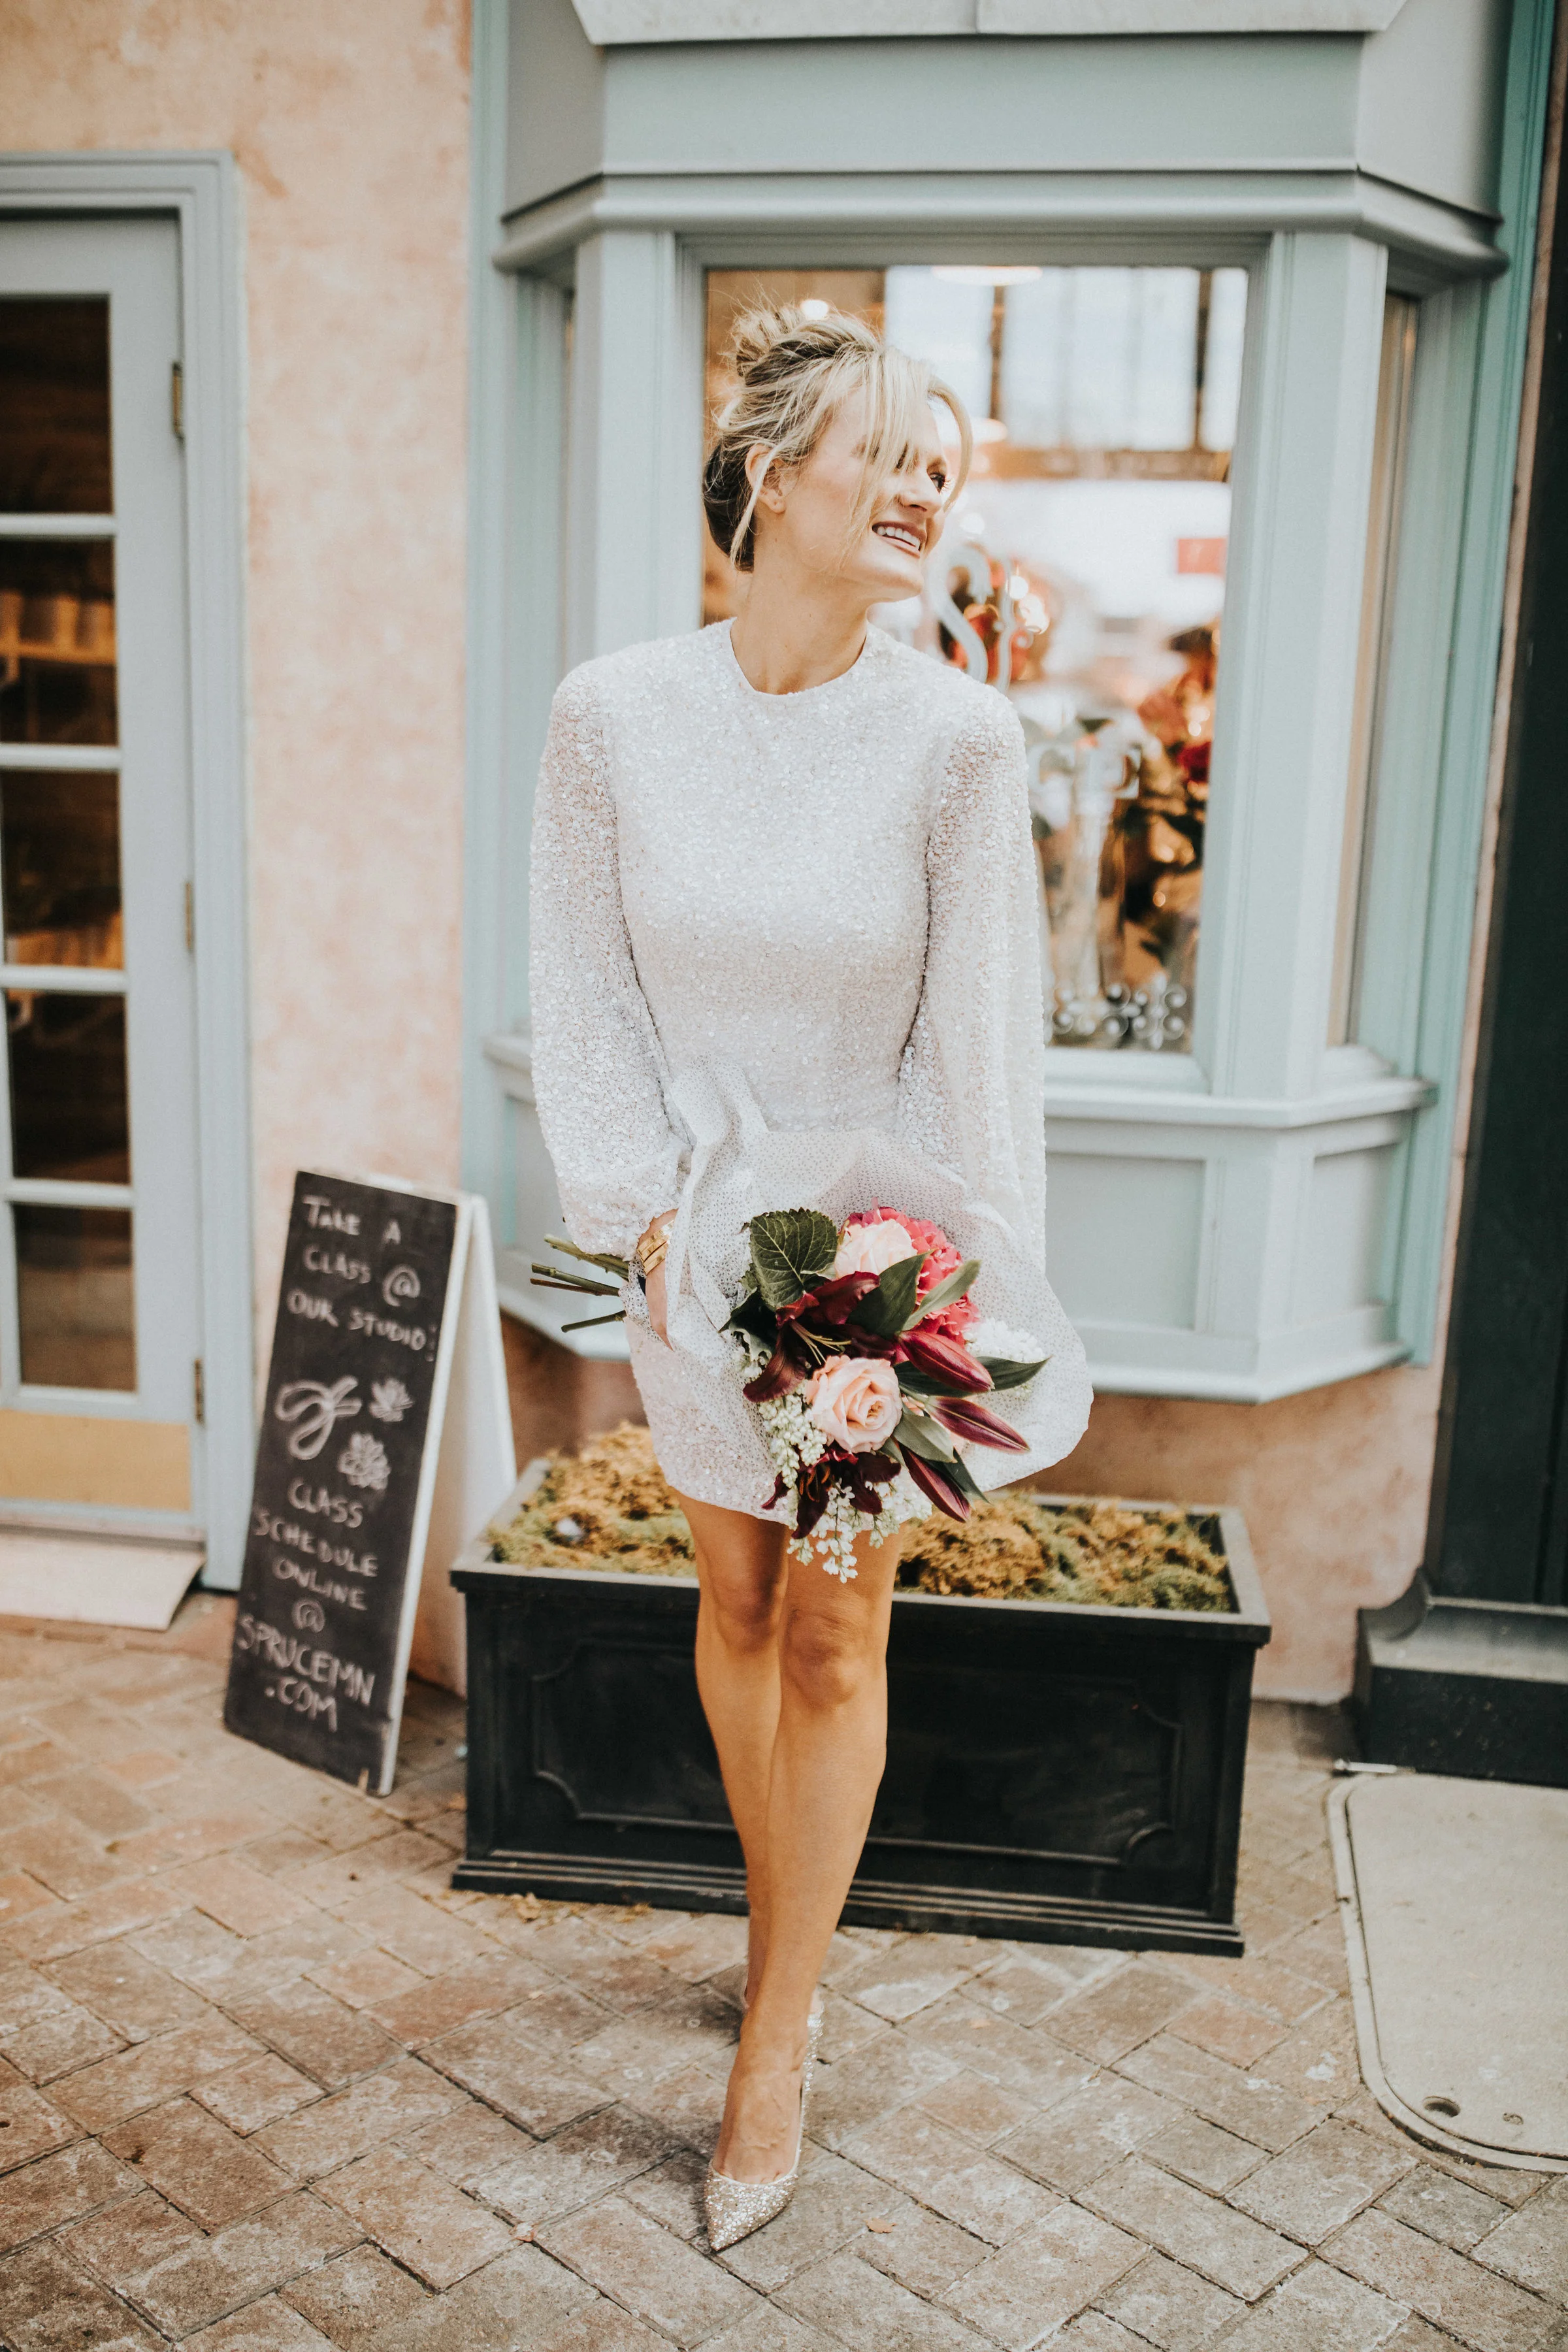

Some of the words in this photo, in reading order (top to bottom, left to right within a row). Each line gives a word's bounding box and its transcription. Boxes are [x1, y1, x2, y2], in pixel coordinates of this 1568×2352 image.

[381, 1219, 401, 1245] A
[303, 1245, 371, 1284] CLASS
[382, 1264, 420, 1307] @
[287, 1289, 339, 1327] OUR
[287, 1476, 363, 1528] CLASS
[252, 1504, 379, 1577] SCHEDULE
[272, 1555, 367, 1610] ONLINE
[292, 1598, 325, 1633] @
[237, 1614, 376, 1707] SPRUCEMN
[265, 1676, 338, 1732] .COM
